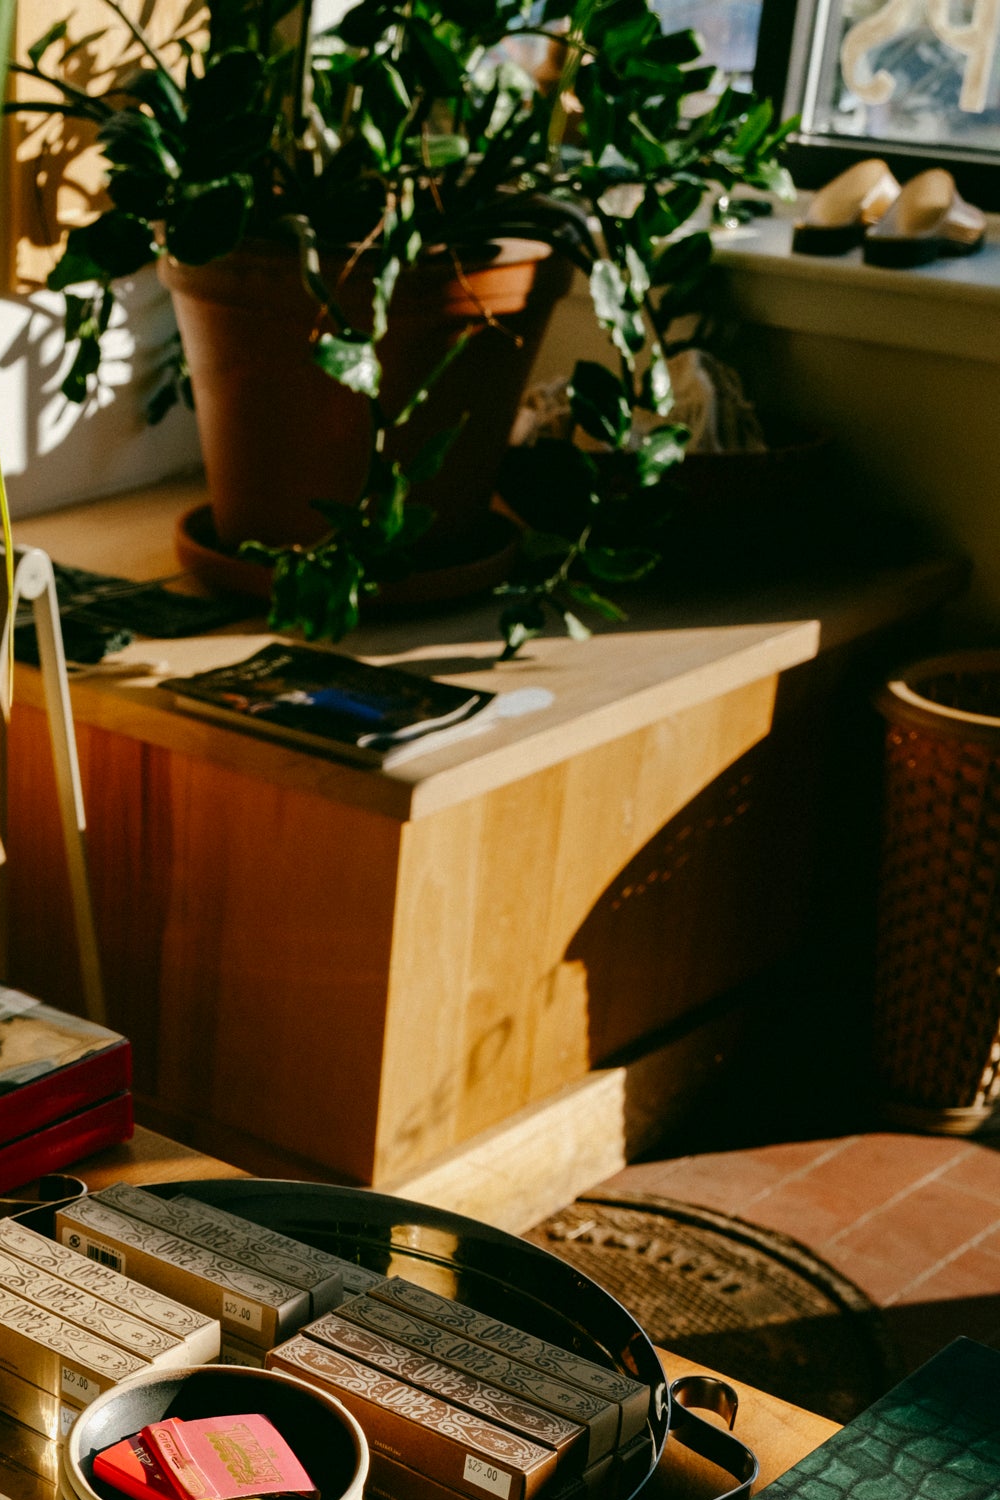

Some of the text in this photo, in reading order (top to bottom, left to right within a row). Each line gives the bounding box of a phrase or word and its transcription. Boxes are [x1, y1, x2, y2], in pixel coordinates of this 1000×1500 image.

[224, 1301, 252, 1321] $25.00
[63, 1368, 89, 1391] $25.00
[467, 1458, 498, 1481] $25.00
